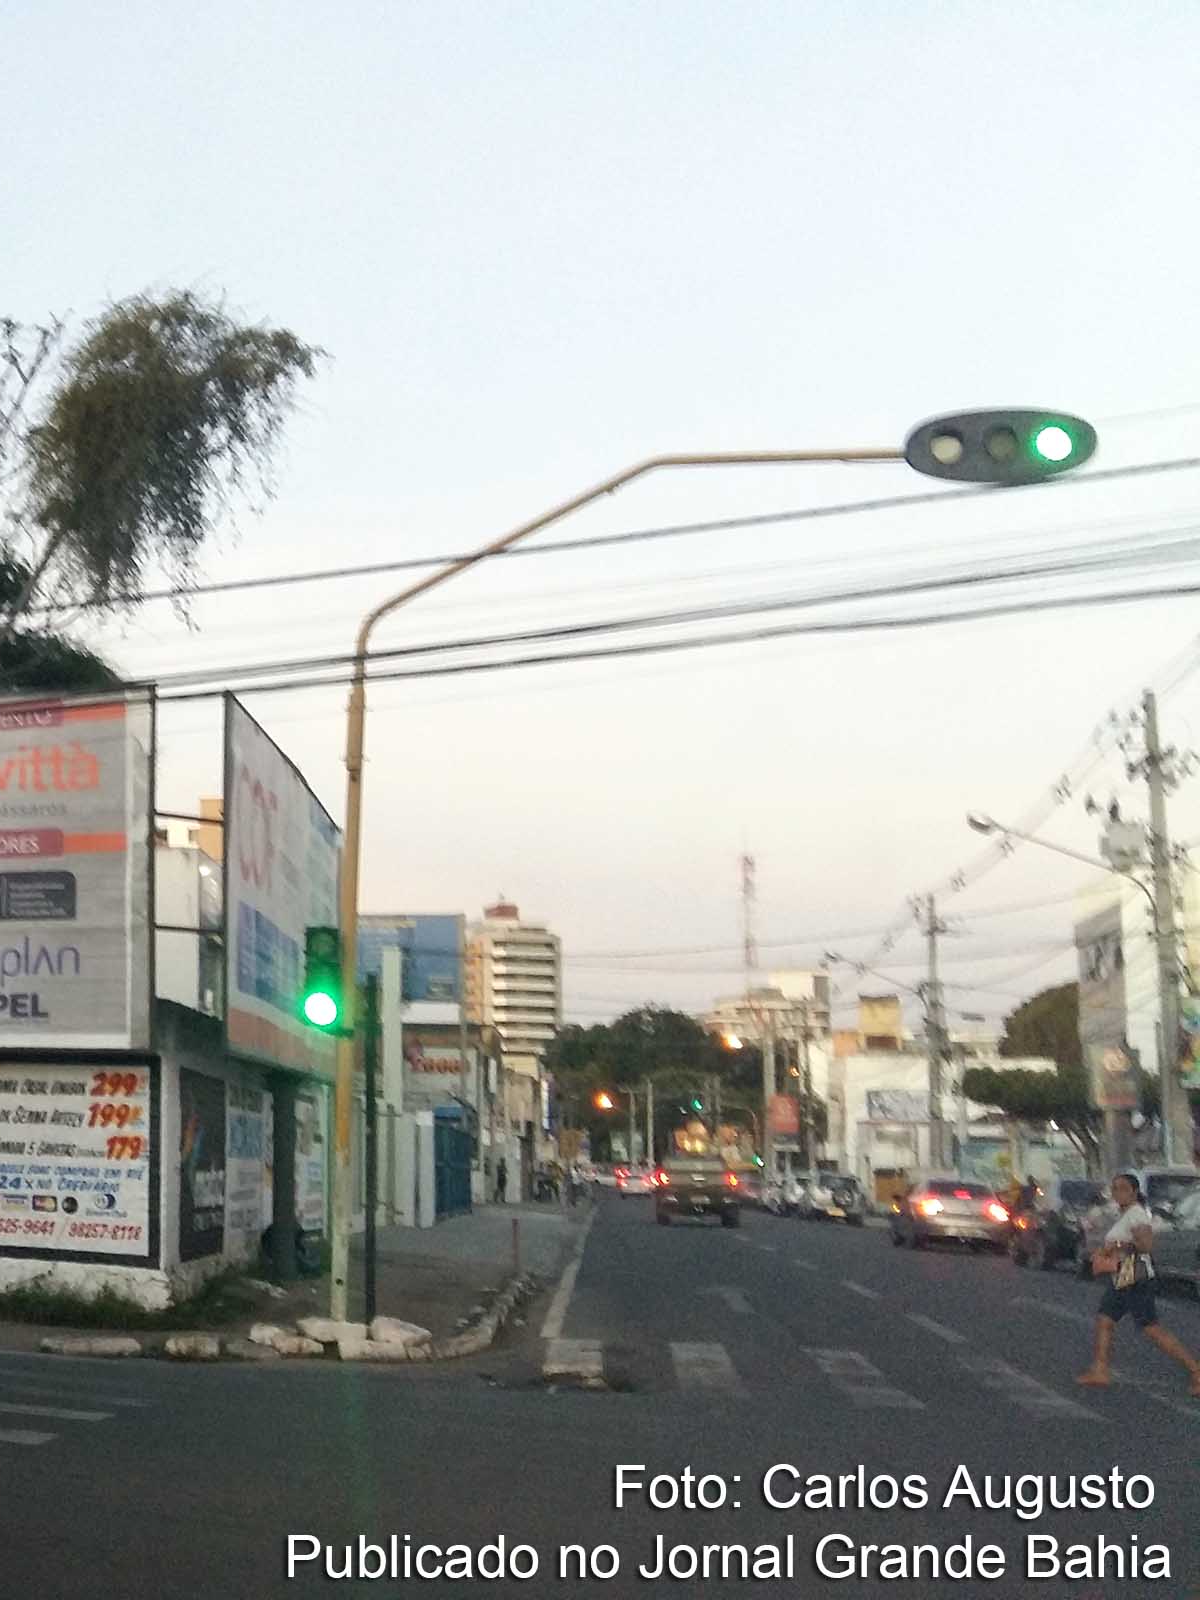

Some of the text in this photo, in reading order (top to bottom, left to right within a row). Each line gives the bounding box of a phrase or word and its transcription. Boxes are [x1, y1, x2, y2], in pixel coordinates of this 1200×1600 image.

[90, 1071, 139, 1097] 299
[88, 1102, 131, 1129] 199
[106, 1135, 143, 1160] 179
